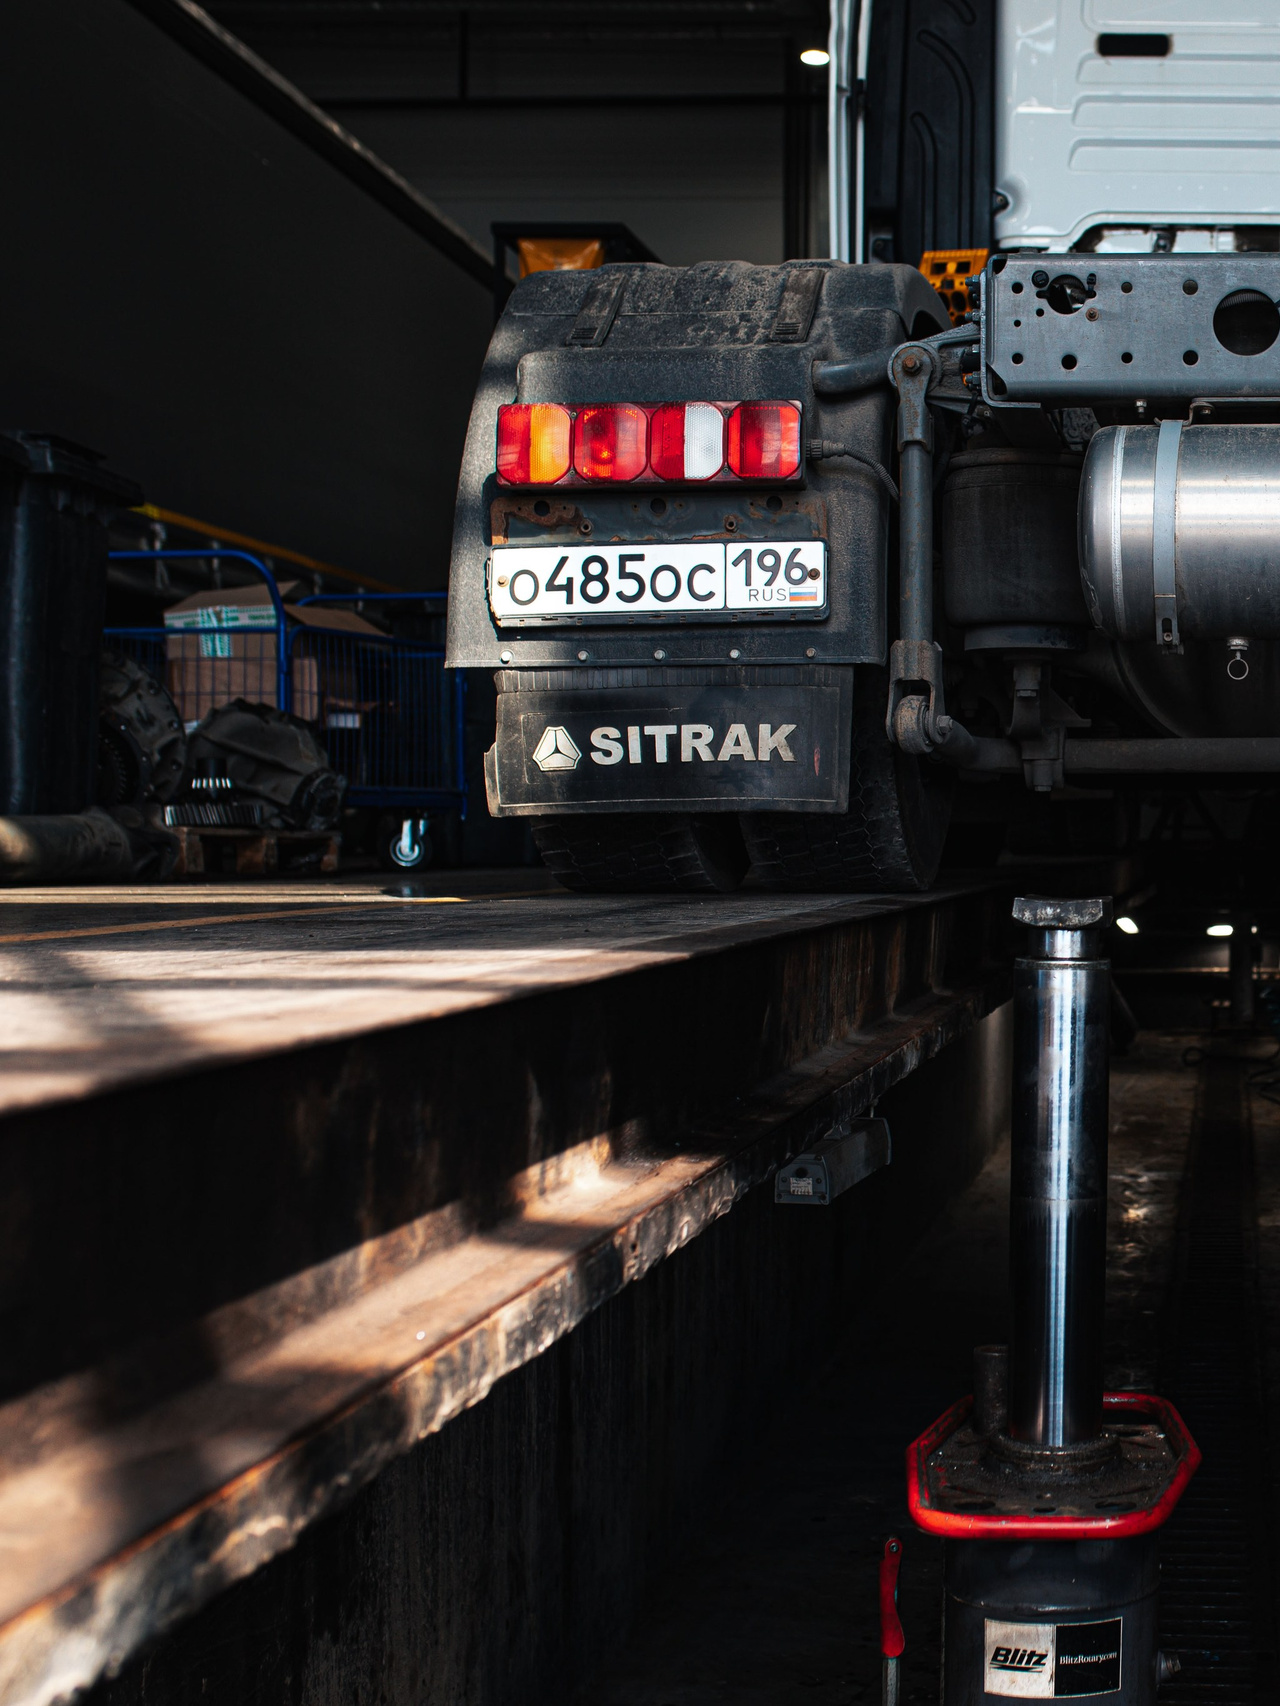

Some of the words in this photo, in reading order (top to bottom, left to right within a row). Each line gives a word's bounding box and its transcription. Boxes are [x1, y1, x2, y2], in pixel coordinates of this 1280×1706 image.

[731, 547, 809, 587] 196
[748, 587, 787, 603] RUS
[590, 723, 797, 766] SITRAK
[990, 1646, 1049, 1668] Blitz
[1059, 1651, 1118, 1666] BlitzRotary.com
